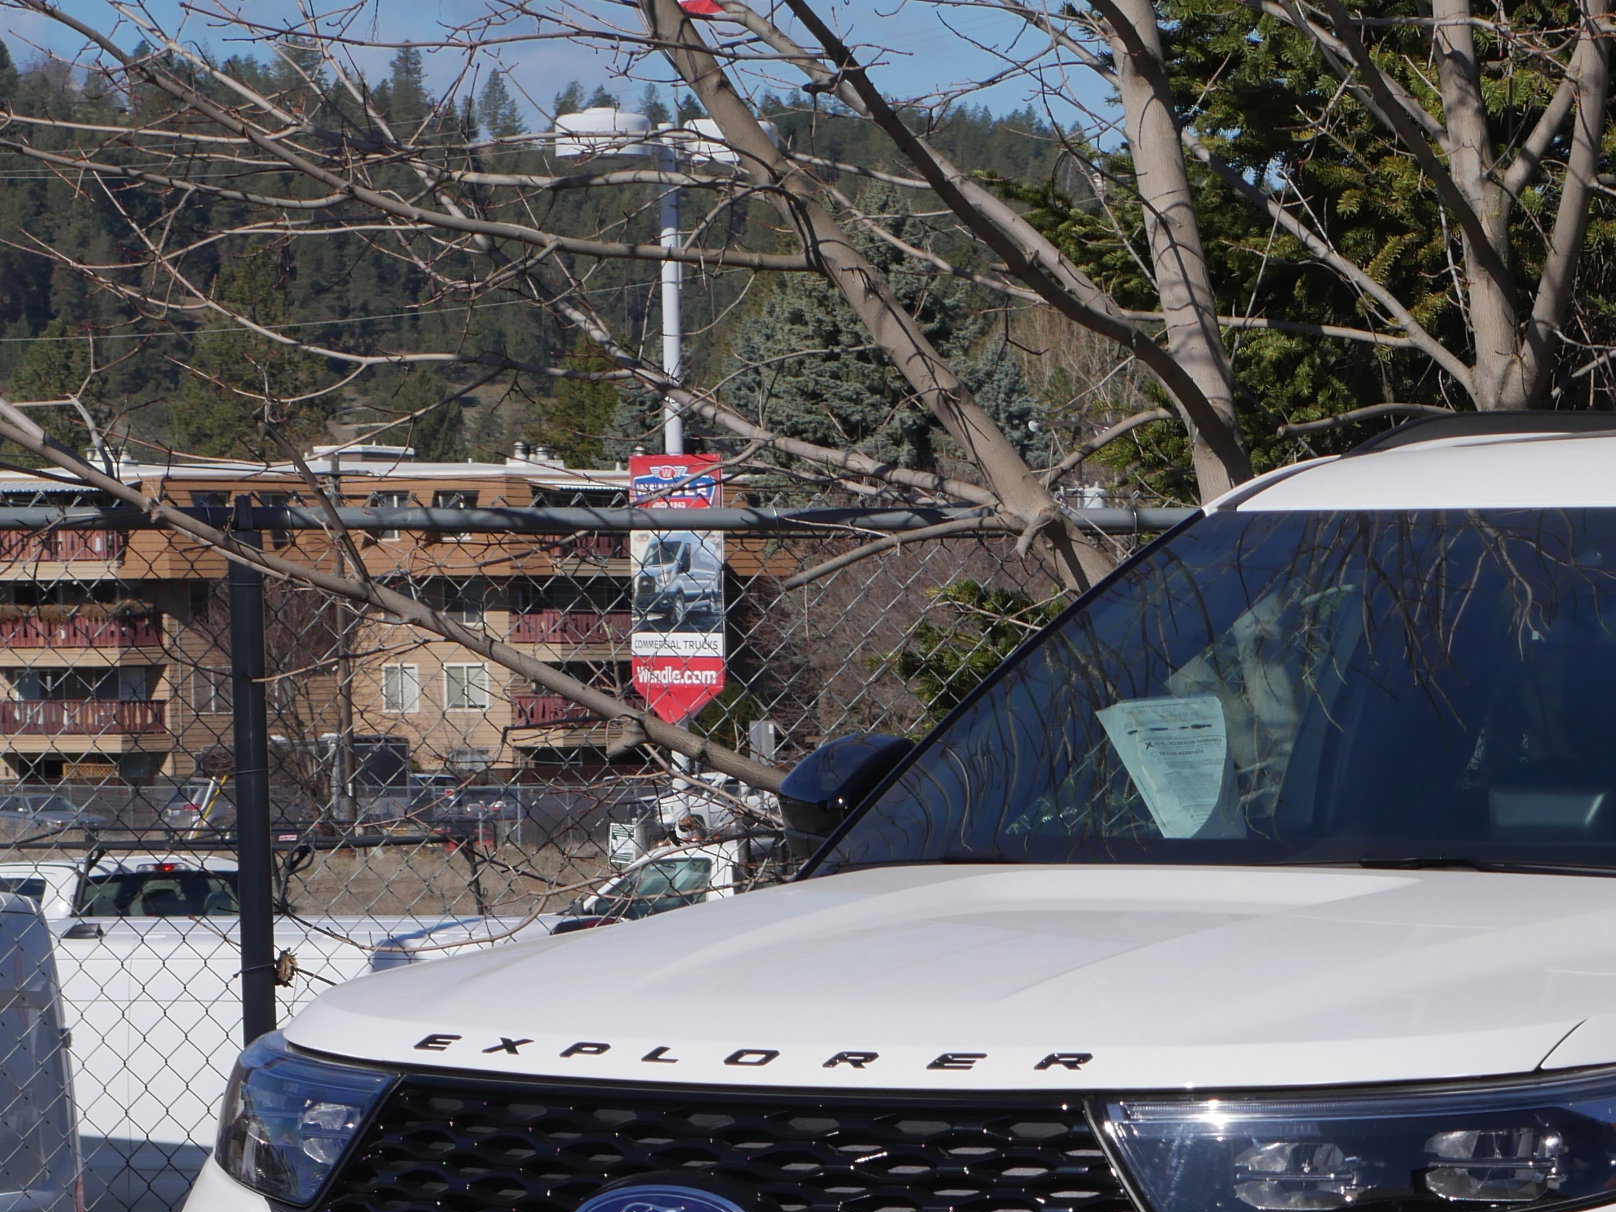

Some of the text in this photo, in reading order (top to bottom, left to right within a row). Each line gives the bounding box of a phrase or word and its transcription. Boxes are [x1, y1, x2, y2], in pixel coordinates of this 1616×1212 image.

[683, 640, 719, 650] TRUCKS
[636, 666, 717, 684] Wendle.com
[413, 1033, 1095, 1072] EXPLORER
